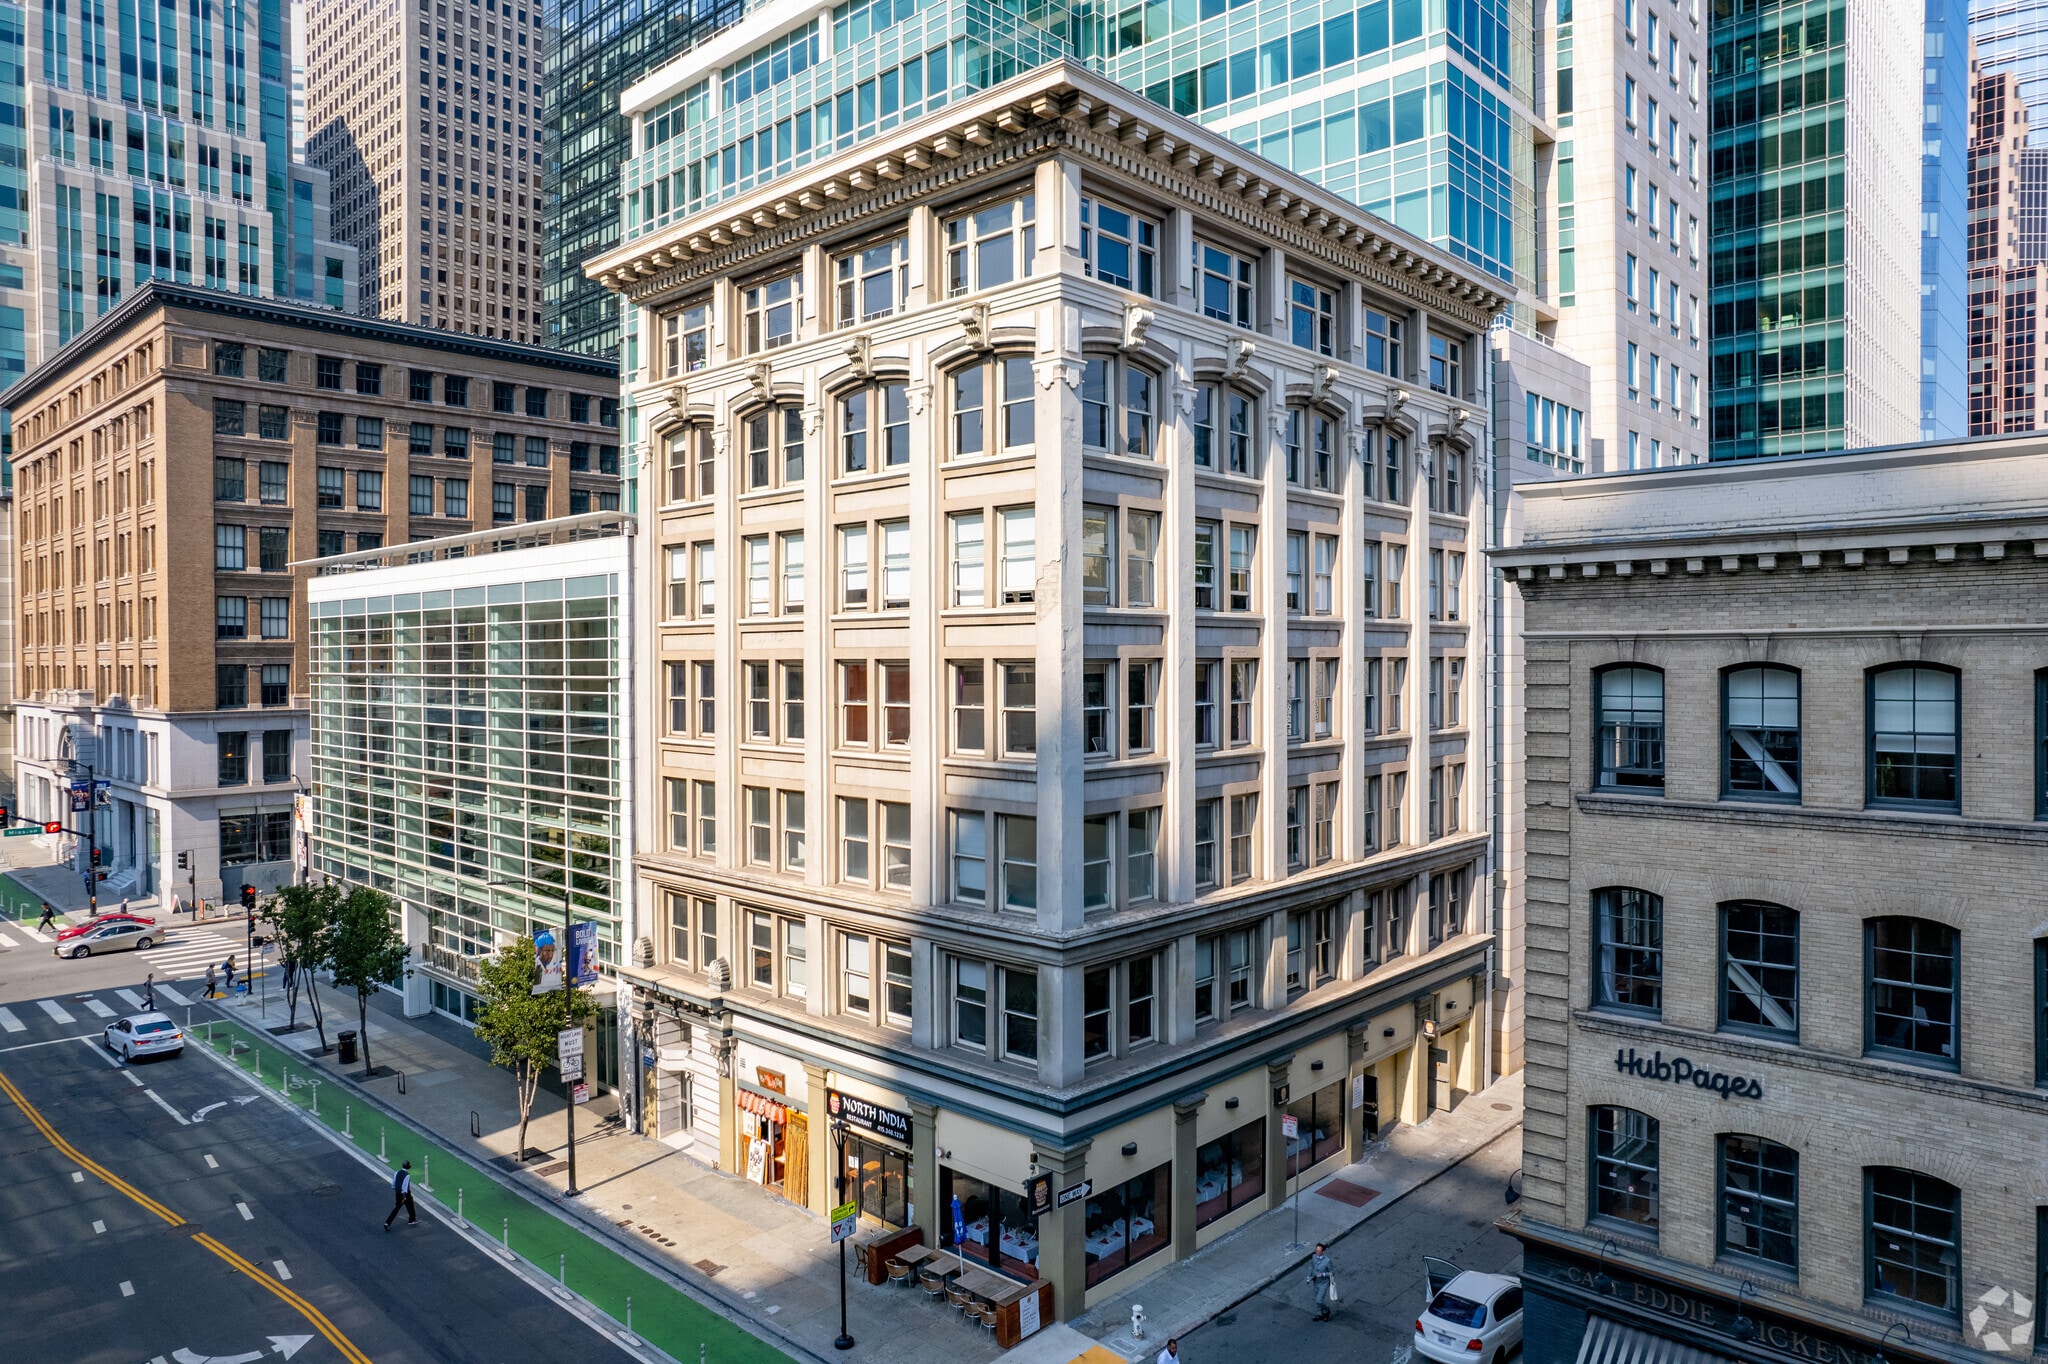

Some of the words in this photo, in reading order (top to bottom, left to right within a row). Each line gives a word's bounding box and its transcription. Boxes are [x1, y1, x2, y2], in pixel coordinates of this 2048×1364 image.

[575, 929, 592, 939] BOLD
[1614, 1048, 1763, 1100] HubPages
[842, 1096, 877, 1120] NORTH
[878, 1109, 908, 1131] INDIA
[846, 1113, 873, 1128] RESTAURANT
[1060, 1192, 1071, 1202] ONE
[1071, 1187, 1083, 1198] WAY
[1567, 1266, 1623, 1296] CAT.
[1632, 1281, 1717, 1326] EDDIE
